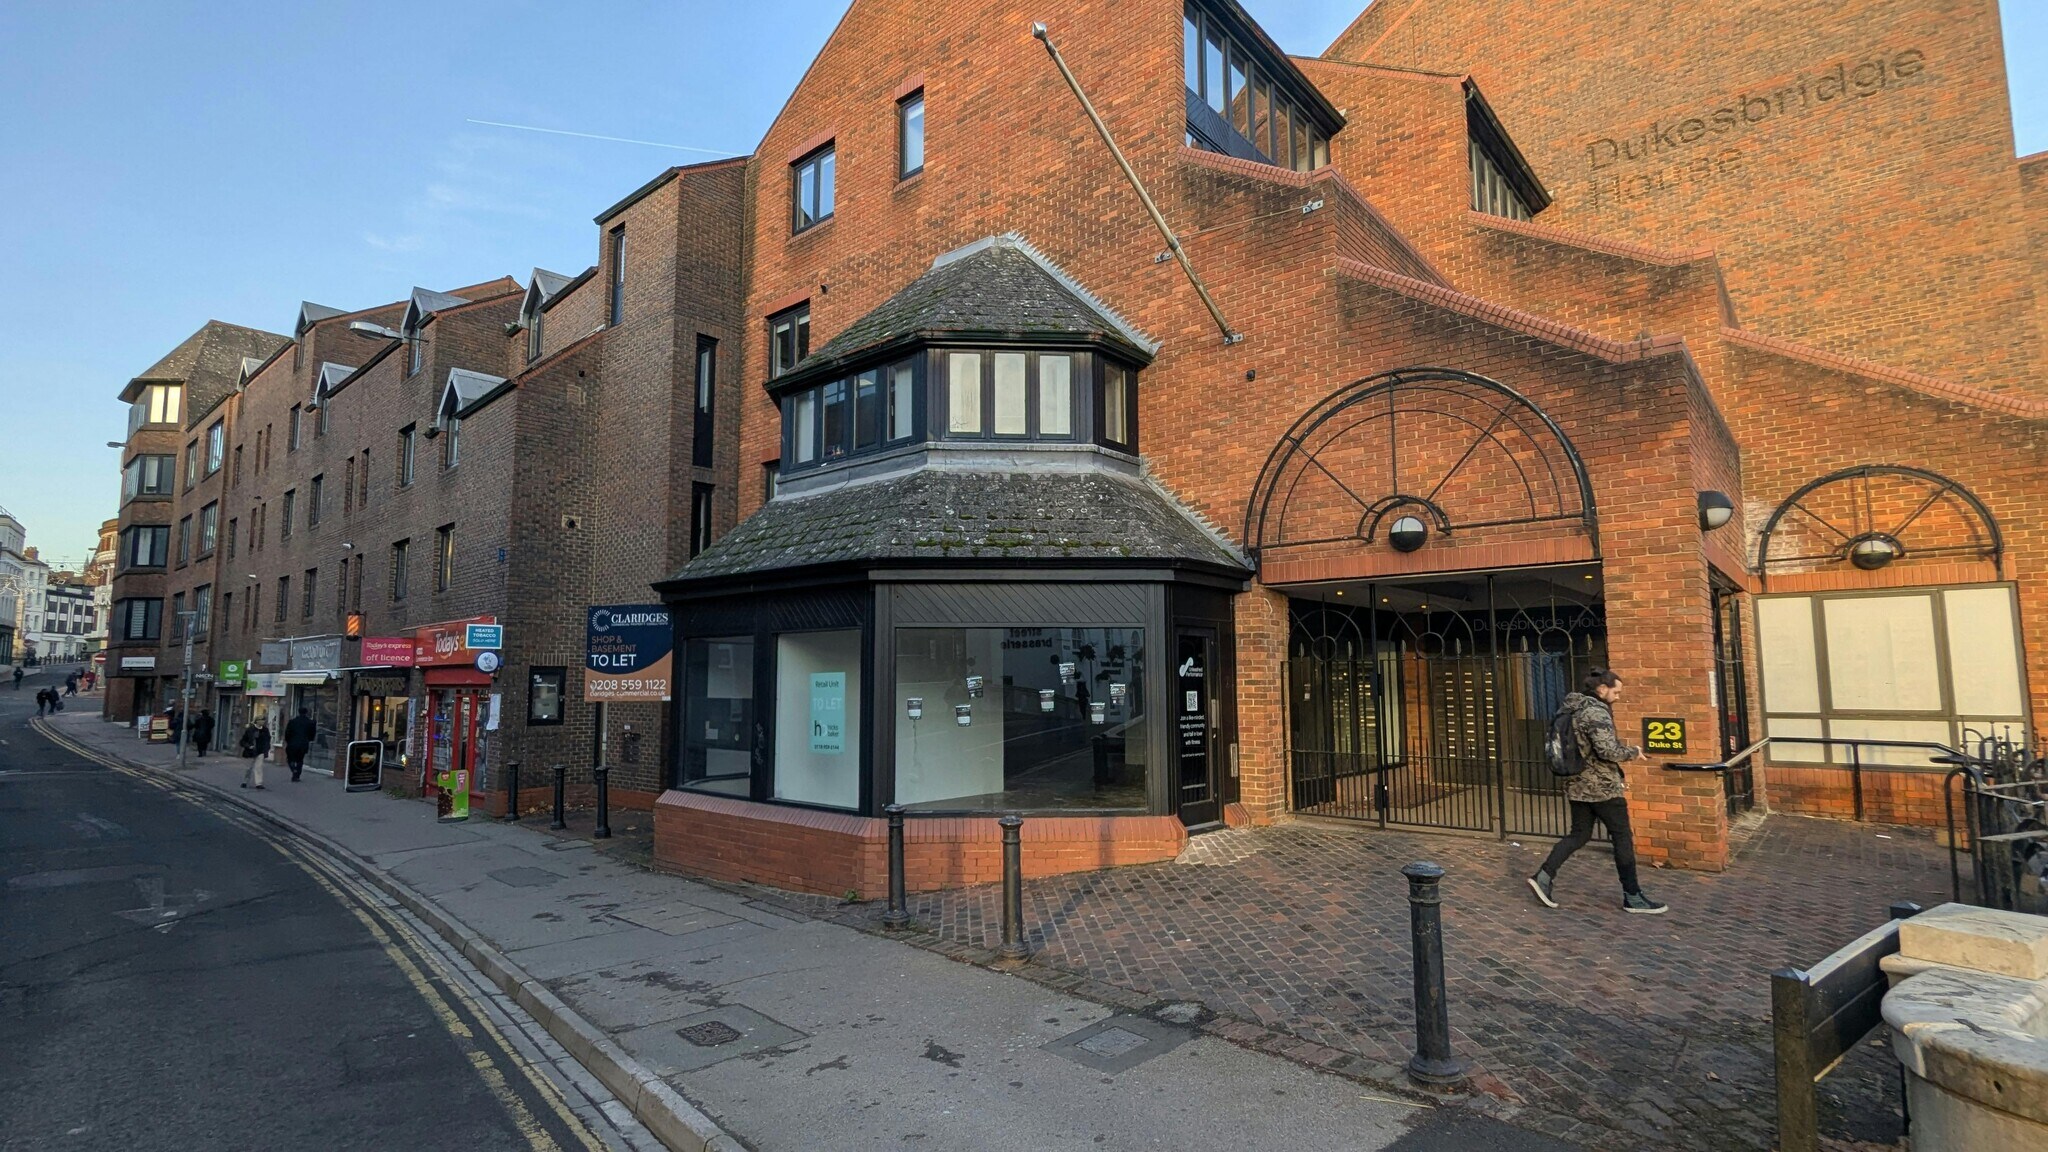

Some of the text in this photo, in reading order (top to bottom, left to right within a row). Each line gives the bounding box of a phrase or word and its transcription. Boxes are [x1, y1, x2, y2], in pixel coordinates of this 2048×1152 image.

[1585, 46, 1926, 170] Dukesbridge
[1589, 146, 1743, 210] House
[611, 613, 669, 624] CLARIDGES
[1473, 615, 1606, 632] Dukesbridge Hous
[435, 631, 460, 656] Today's
[592, 635, 623, 644] SHOP &
[366, 642, 388, 650] Today's
[592, 644, 637, 653] BASEMENT
[366, 654, 379, 662] off
[380, 654, 411, 662] licence
[591, 654, 637, 667] TO LET
[590, 679, 667, 690] 0208 559 1122
[815, 680, 839, 688] Retail Unit
[590, 690, 666, 698] claridgescommercial.co.uk
[813, 697, 842, 710] TO LET
[1648, 722, 1682, 740] 23
[1672, 741, 1683, 749] St
